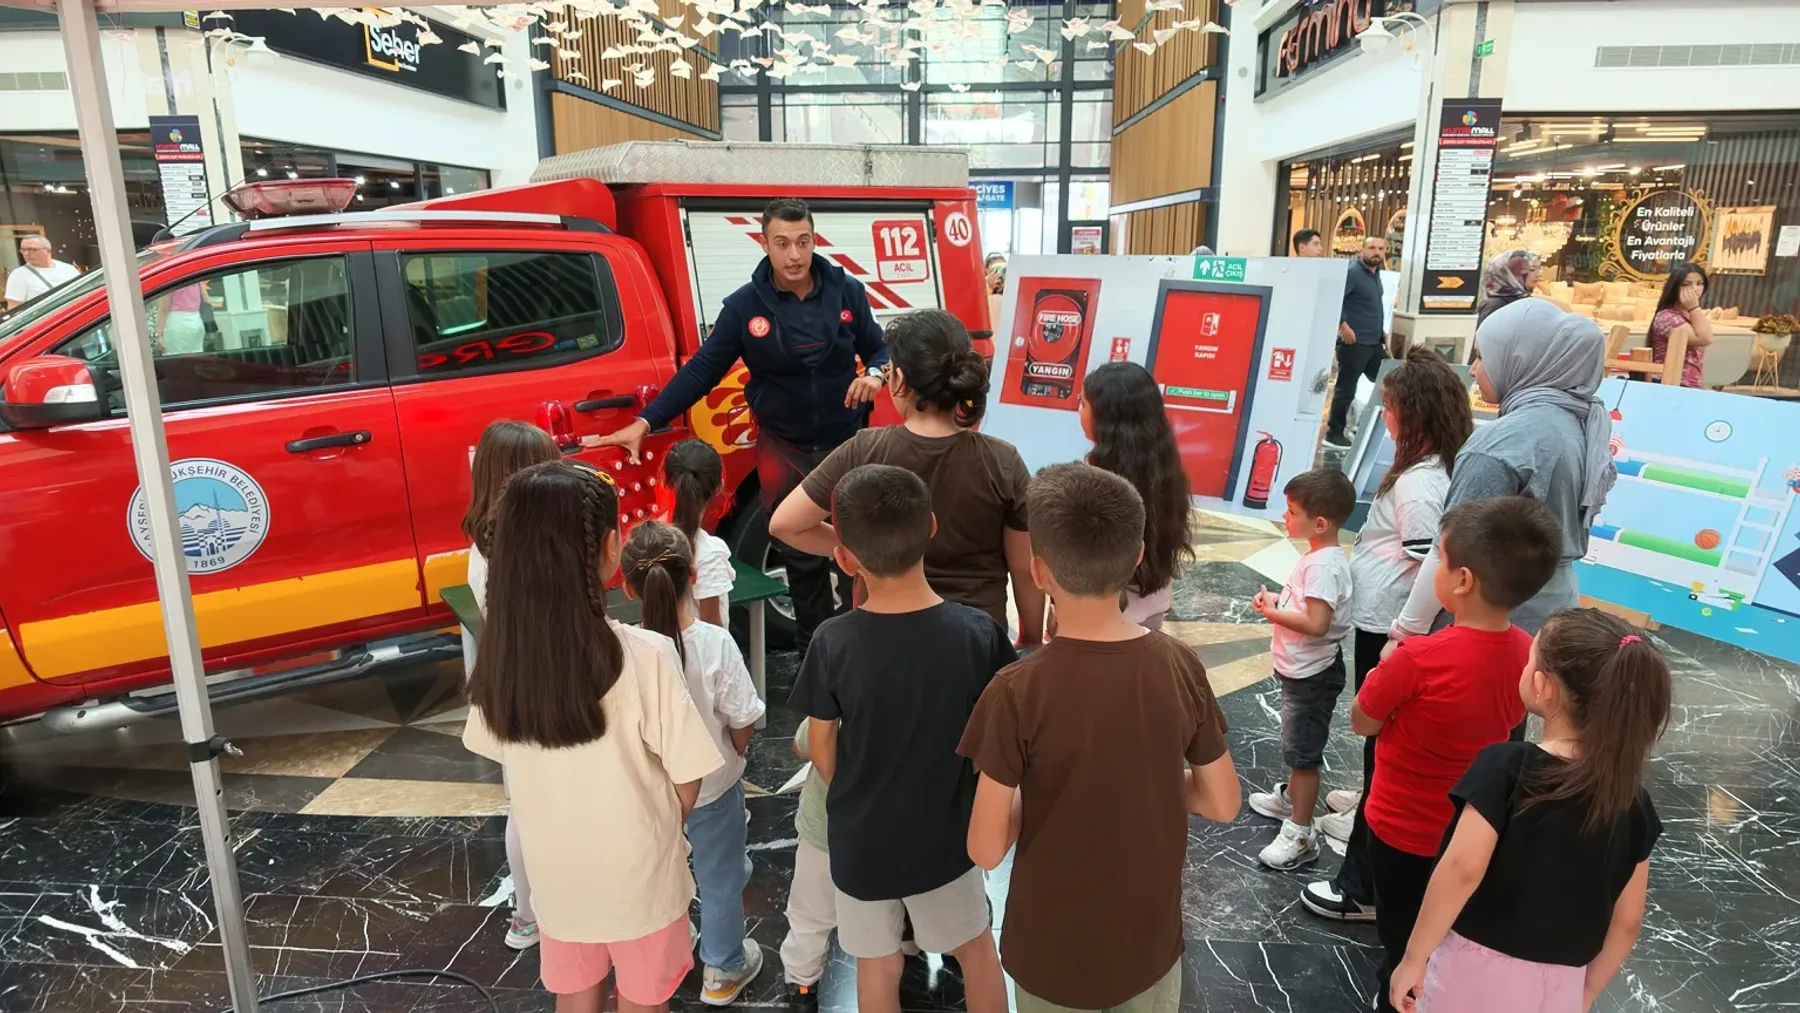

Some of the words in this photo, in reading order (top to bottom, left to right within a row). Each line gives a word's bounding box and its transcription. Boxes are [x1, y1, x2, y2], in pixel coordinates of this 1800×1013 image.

[969, 184, 1006, 194] CİYES
[1636, 207, 1653, 217] En
[1654, 206, 1695, 217] Kaliteli
[949, 218, 969, 241] 40
[1641, 219, 1685, 232] Ürünler
[880, 226, 920, 257] 112
[1626, 235, 1642, 246] En
[1631, 249, 1686, 262] Fiyatlarla
[1040, 314, 1057, 322] FIRE
[1057, 314, 1080, 323] HOSE
[1032, 365, 1070, 376] YANGIN
[229, 474, 262, 534] BELEDİYESİ
[193, 556, 226, 568] 1869
